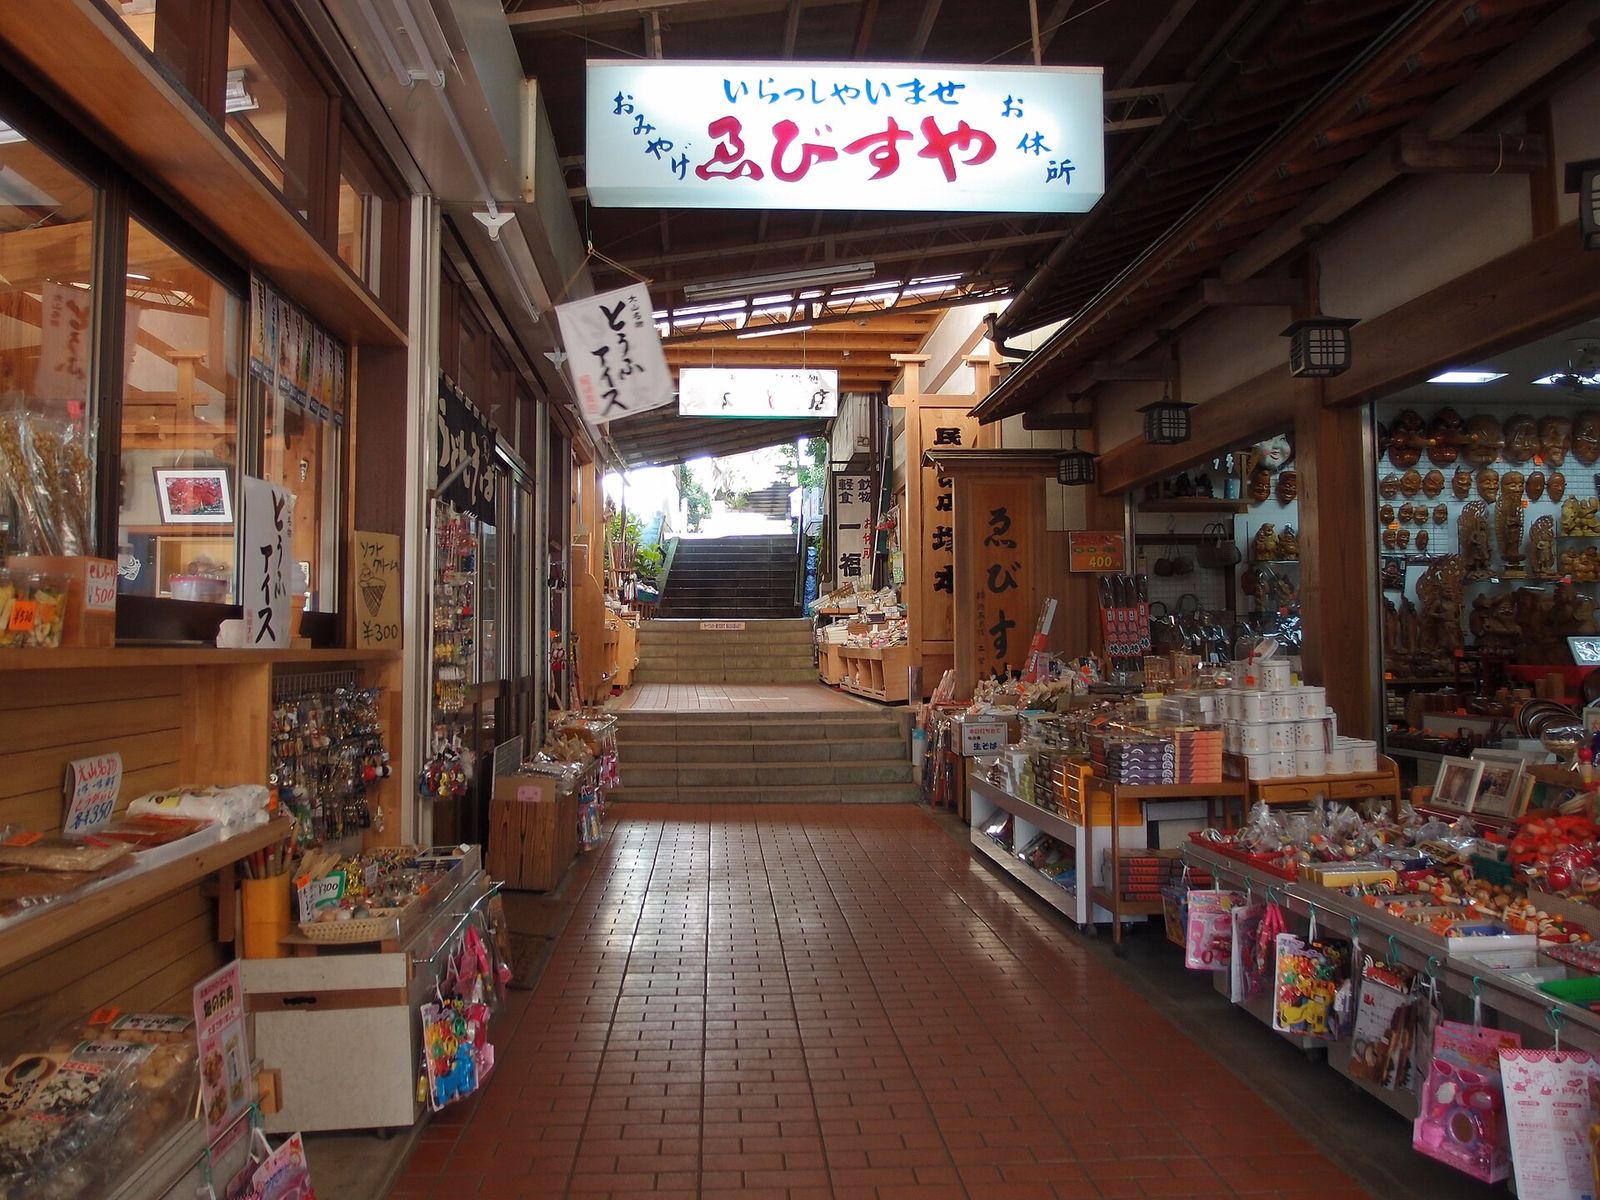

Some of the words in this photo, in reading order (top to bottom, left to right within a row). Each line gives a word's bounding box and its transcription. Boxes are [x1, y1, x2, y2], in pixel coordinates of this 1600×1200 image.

[723, 78, 966, 106] いらっしゃいませ
[612, 90, 691, 181] おみやげ
[695, 115, 997, 184] ゑびすや
[1001, 95, 1077, 186] お休所
[600, 300, 646, 380] とうふ
[591, 345, 628, 416] アイス
[838, 478, 854, 504] 軽食
[857, 478, 871, 503] 飲物
[272, 489, 287, 600] とうふ
[360, 541, 385, 558] ソフト
[838, 523, 862, 577] 一福
[372, 558, 399, 573] クリーム
[256, 543, 276, 644] アイス
[362, 621, 399, 644] ¥300
[973, 742, 998, 751] 生そば
[318, 882, 339, 895] ¥300
